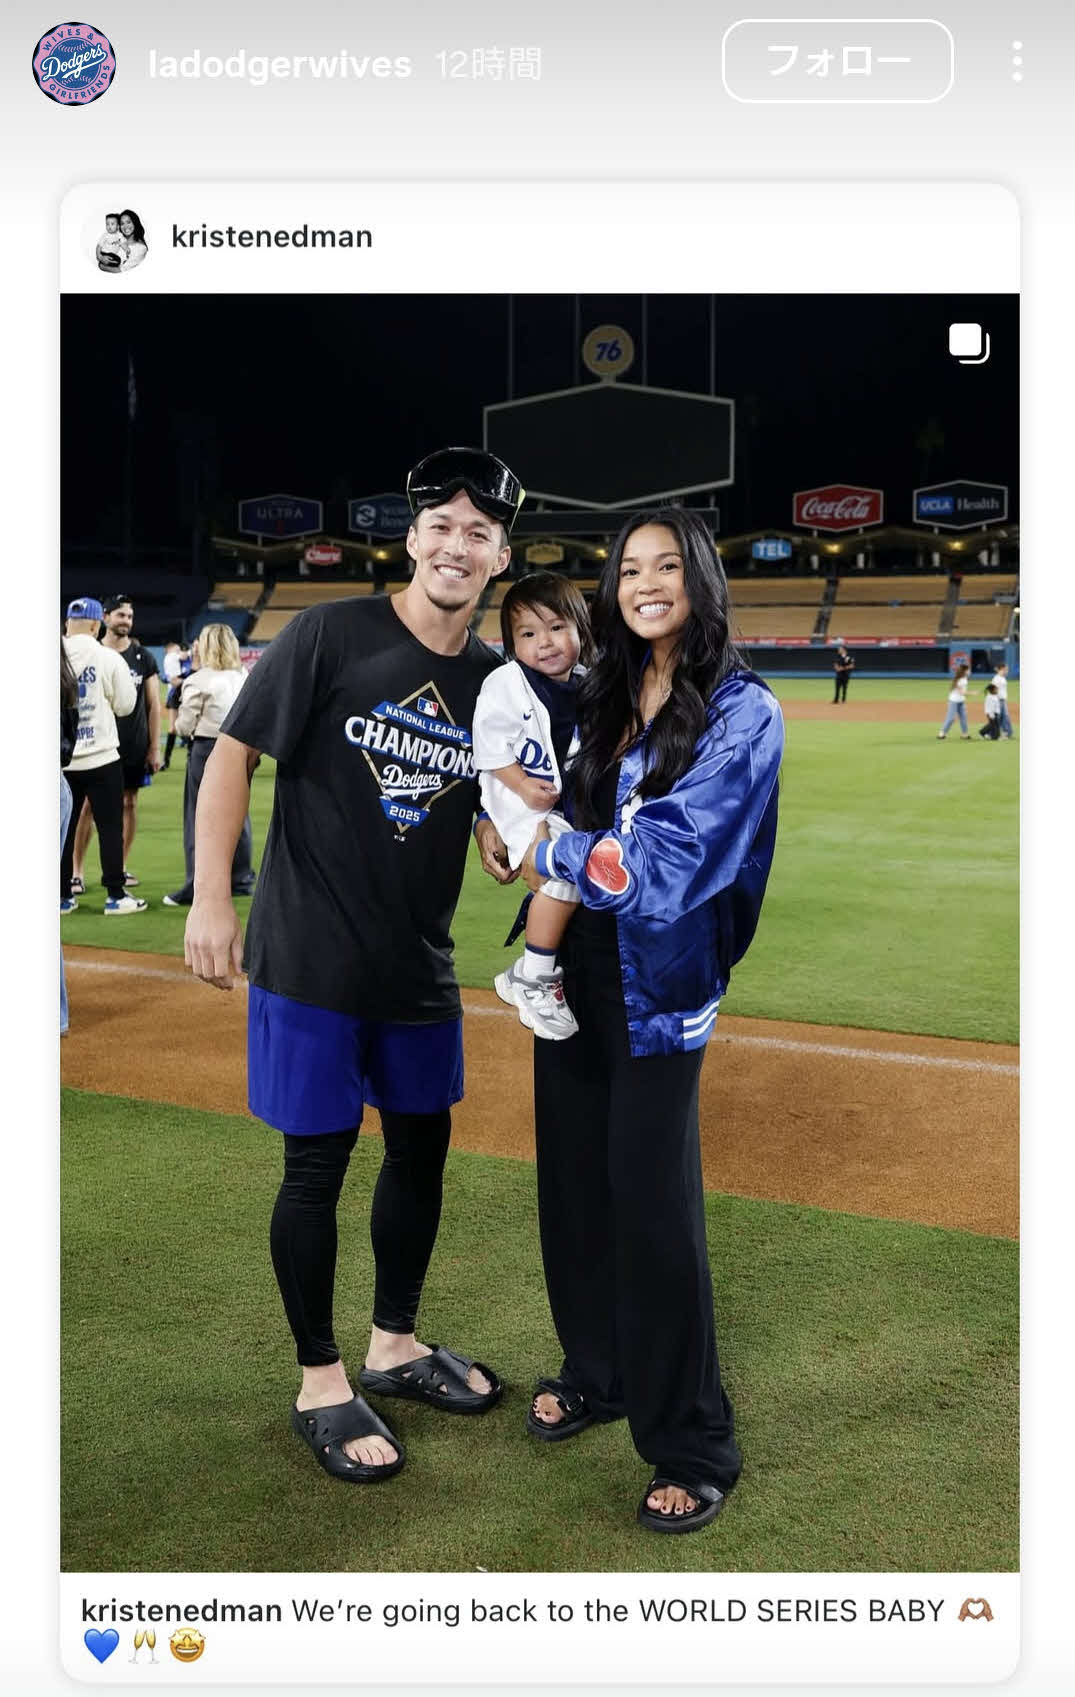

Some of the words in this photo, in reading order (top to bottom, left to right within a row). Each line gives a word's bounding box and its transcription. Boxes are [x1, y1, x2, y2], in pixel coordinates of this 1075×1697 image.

[595, 339, 622, 362] 76
[256, 507, 303, 519] ULTRA
[920, 499, 951, 512] UCLA
[957, 497, 1000, 511] Health
[758, 542, 787, 558] TEL
[385, 705, 427, 730] NATIONAL
[429, 721, 465, 741] LEAGUE
[344, 715, 478, 780] CHAMPIONS
[380, 764, 444, 801] Dodgers
[389, 805, 421, 822] 2025
